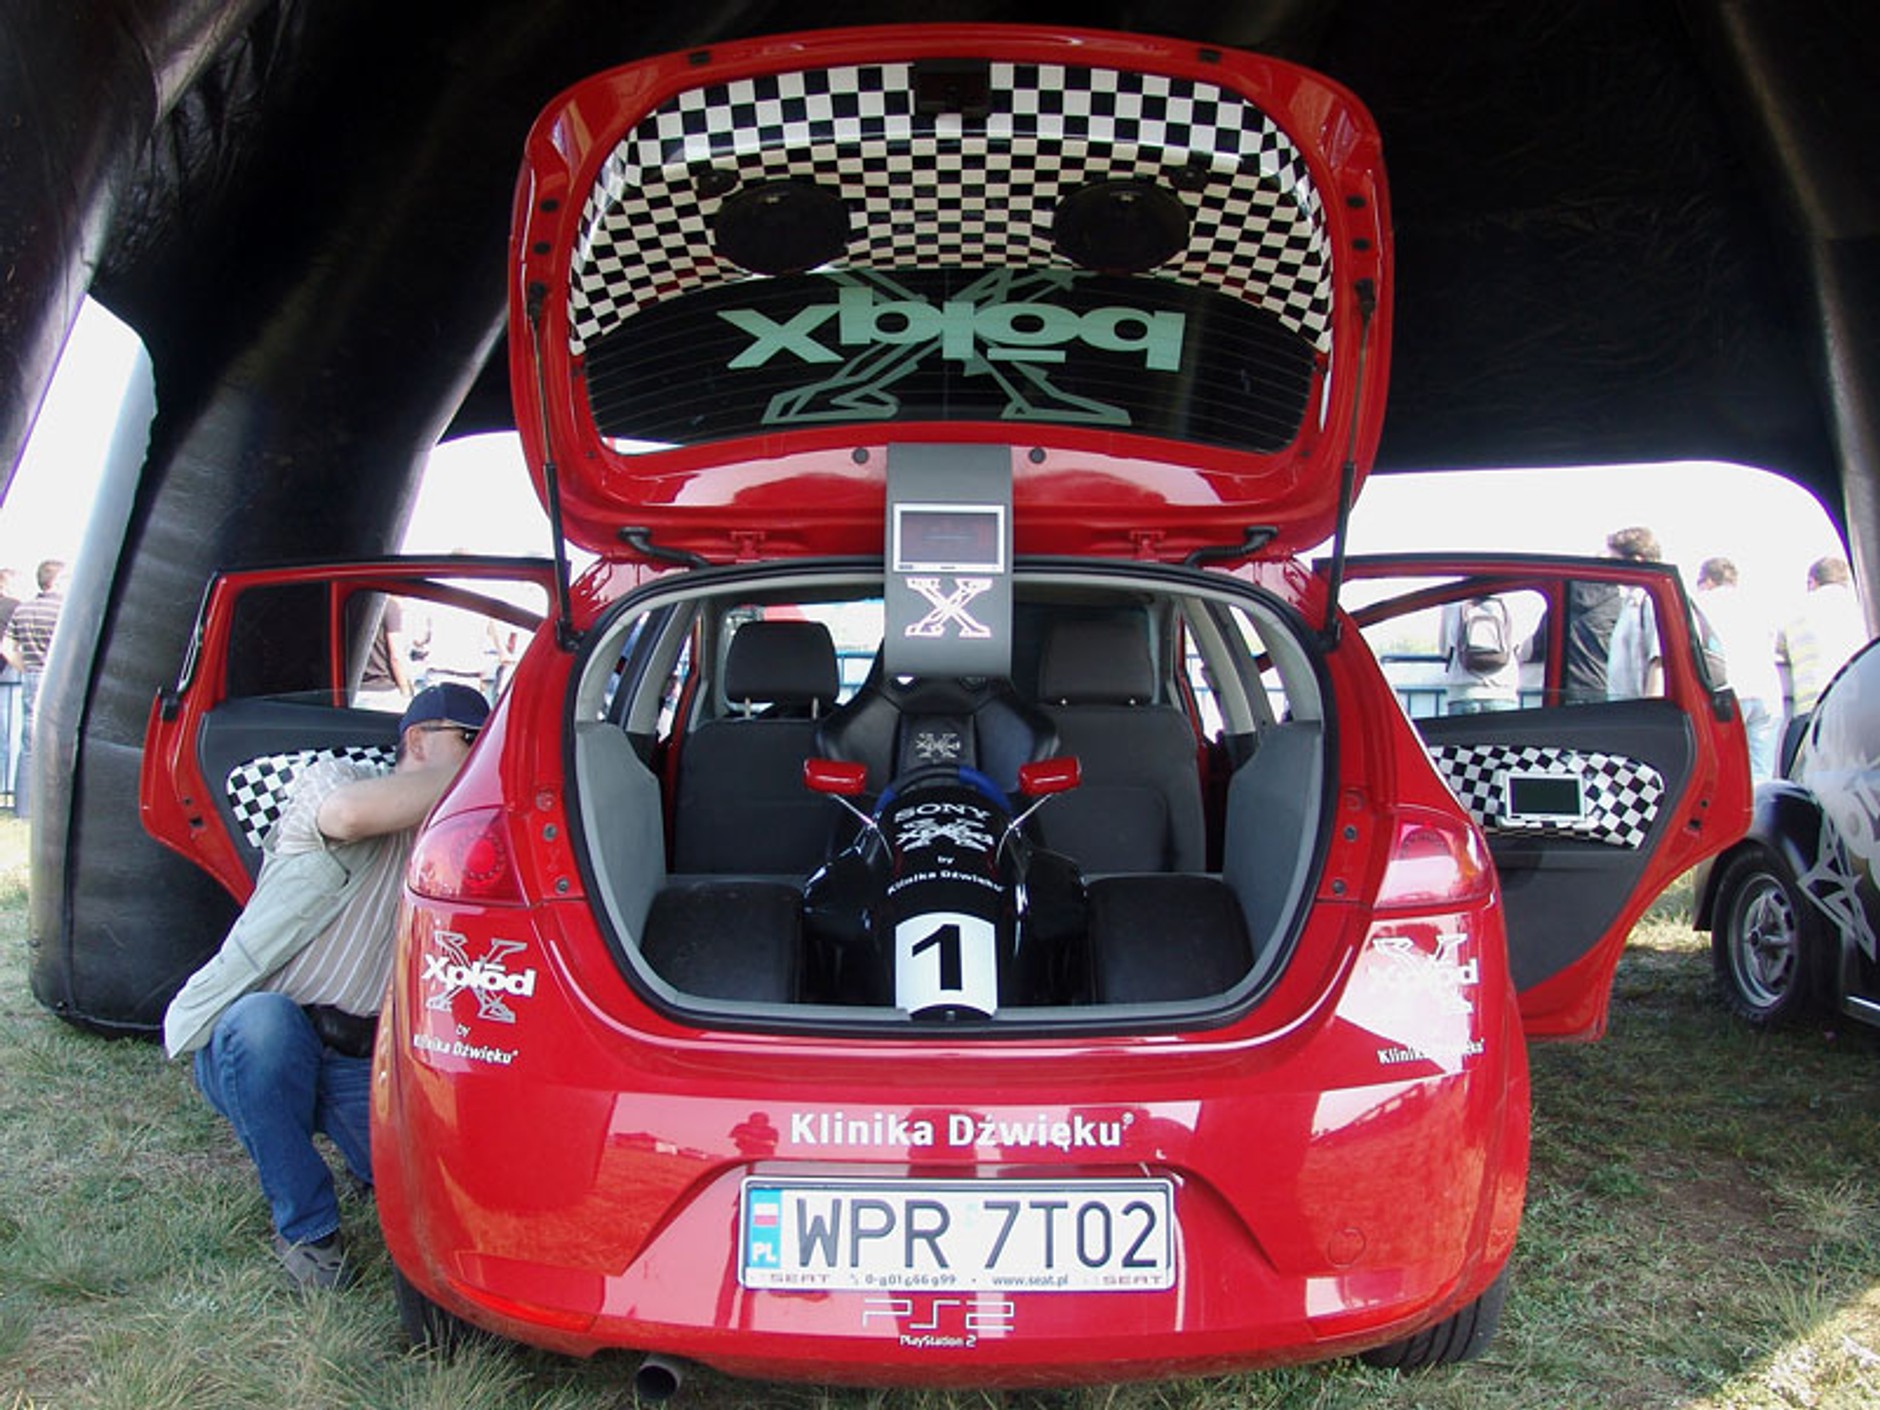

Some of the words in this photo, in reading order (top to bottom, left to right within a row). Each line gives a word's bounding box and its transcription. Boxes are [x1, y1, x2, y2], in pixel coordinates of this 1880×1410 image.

[895, 803, 991, 822] SONY
[937, 855, 955, 865] by
[911, 924, 963, 992] 1
[790, 1112, 934, 1146] Klinika
[752, 1242, 777, 1262] PL
[796, 1198, 951, 1269] WPR
[983, 1200, 1159, 1269] 7T02
[770, 1273, 831, 1284] SEAT
[992, 1274, 1069, 1287] www.seat.pl
[1102, 1275, 1164, 1285] SEAT
[862, 1298, 1015, 1332] PS2
[900, 1334, 965, 1348] PlayStation
[966, 1334, 978, 1348] 2
